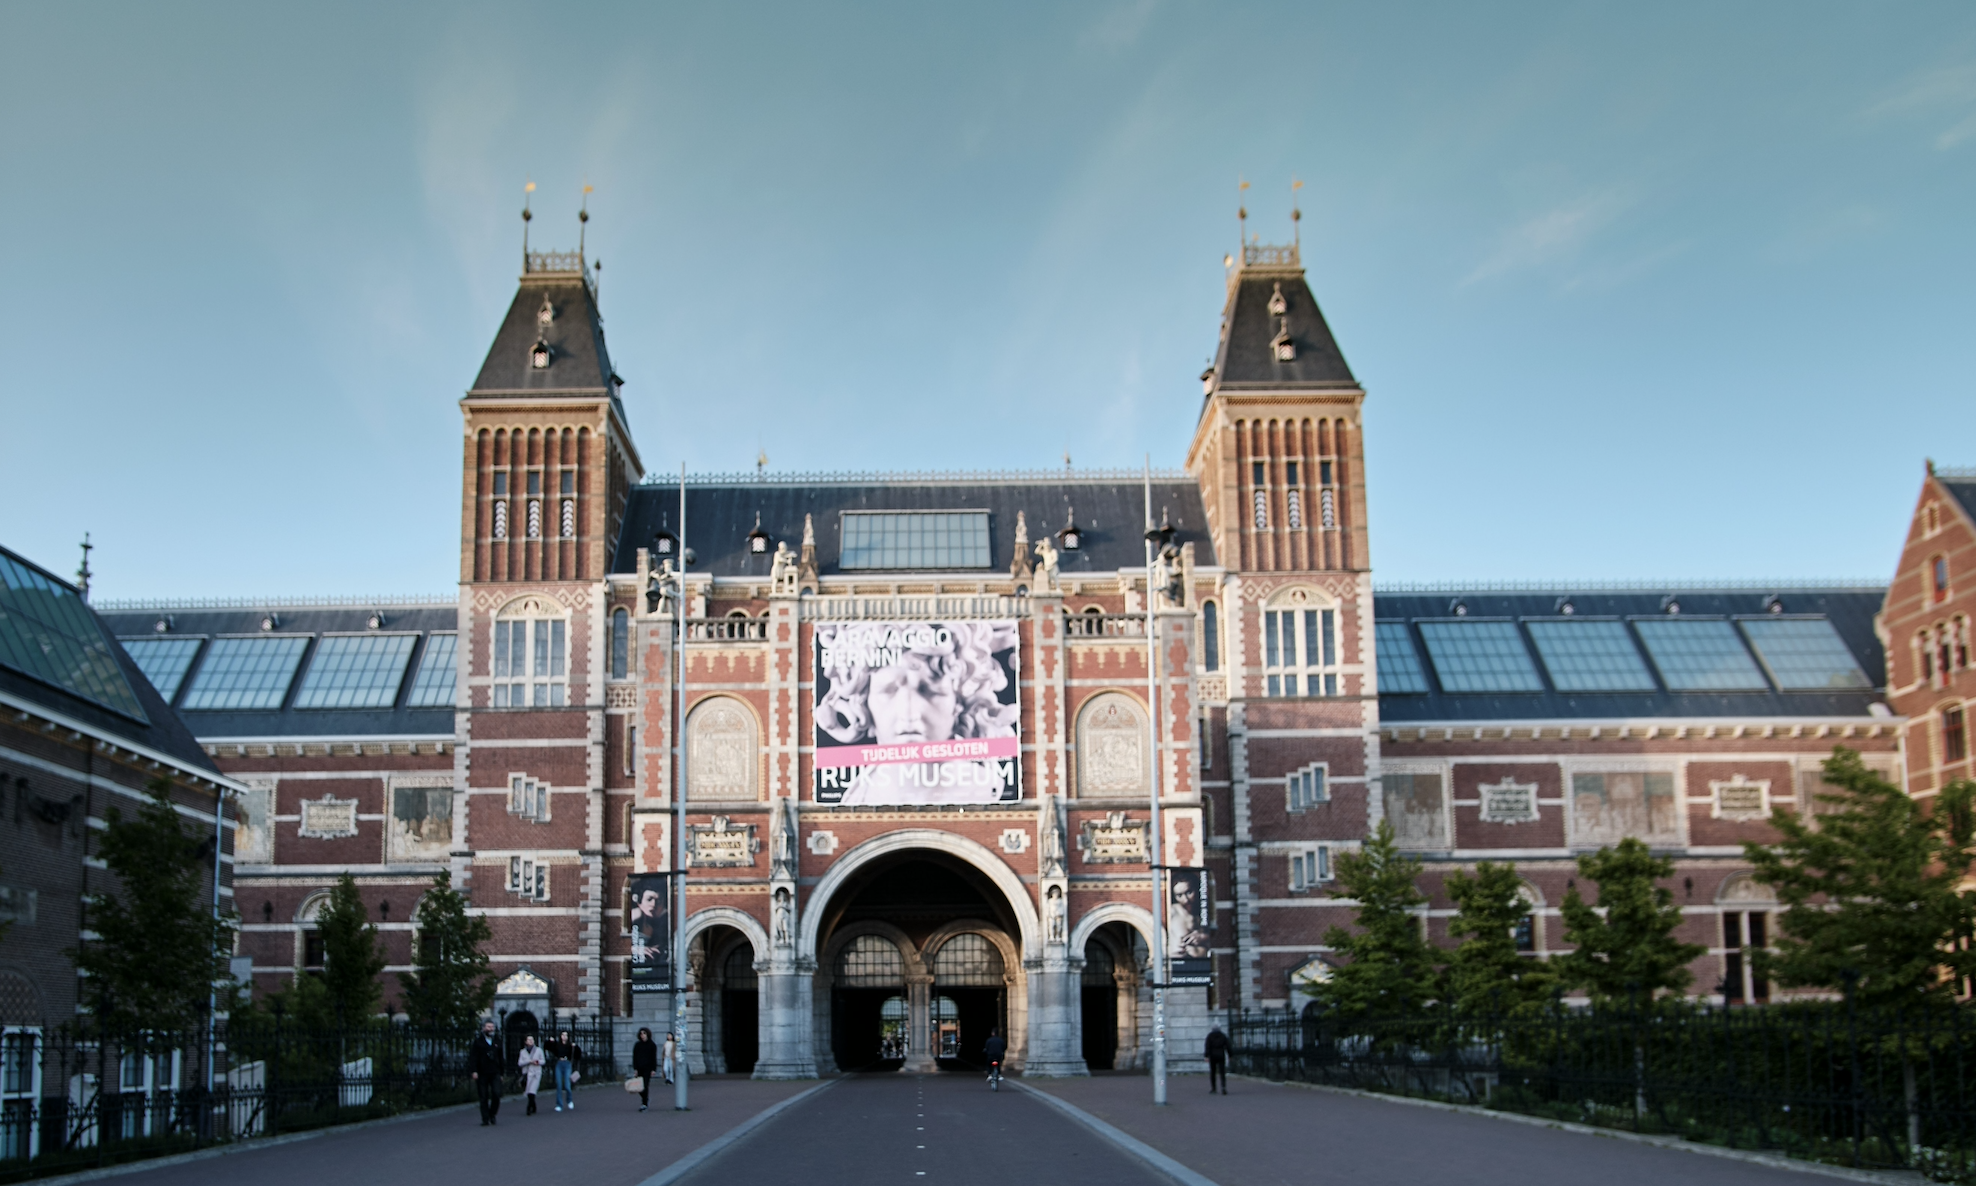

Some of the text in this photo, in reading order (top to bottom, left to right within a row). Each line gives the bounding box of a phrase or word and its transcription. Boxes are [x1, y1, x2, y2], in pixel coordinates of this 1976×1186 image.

[820, 628, 952, 649] CARAVAGGIO
[822, 648, 901, 668] BERNINI
[922, 742, 988, 758] GESLOTEN
[821, 761, 1014, 788] RIJKS MUSEUM
